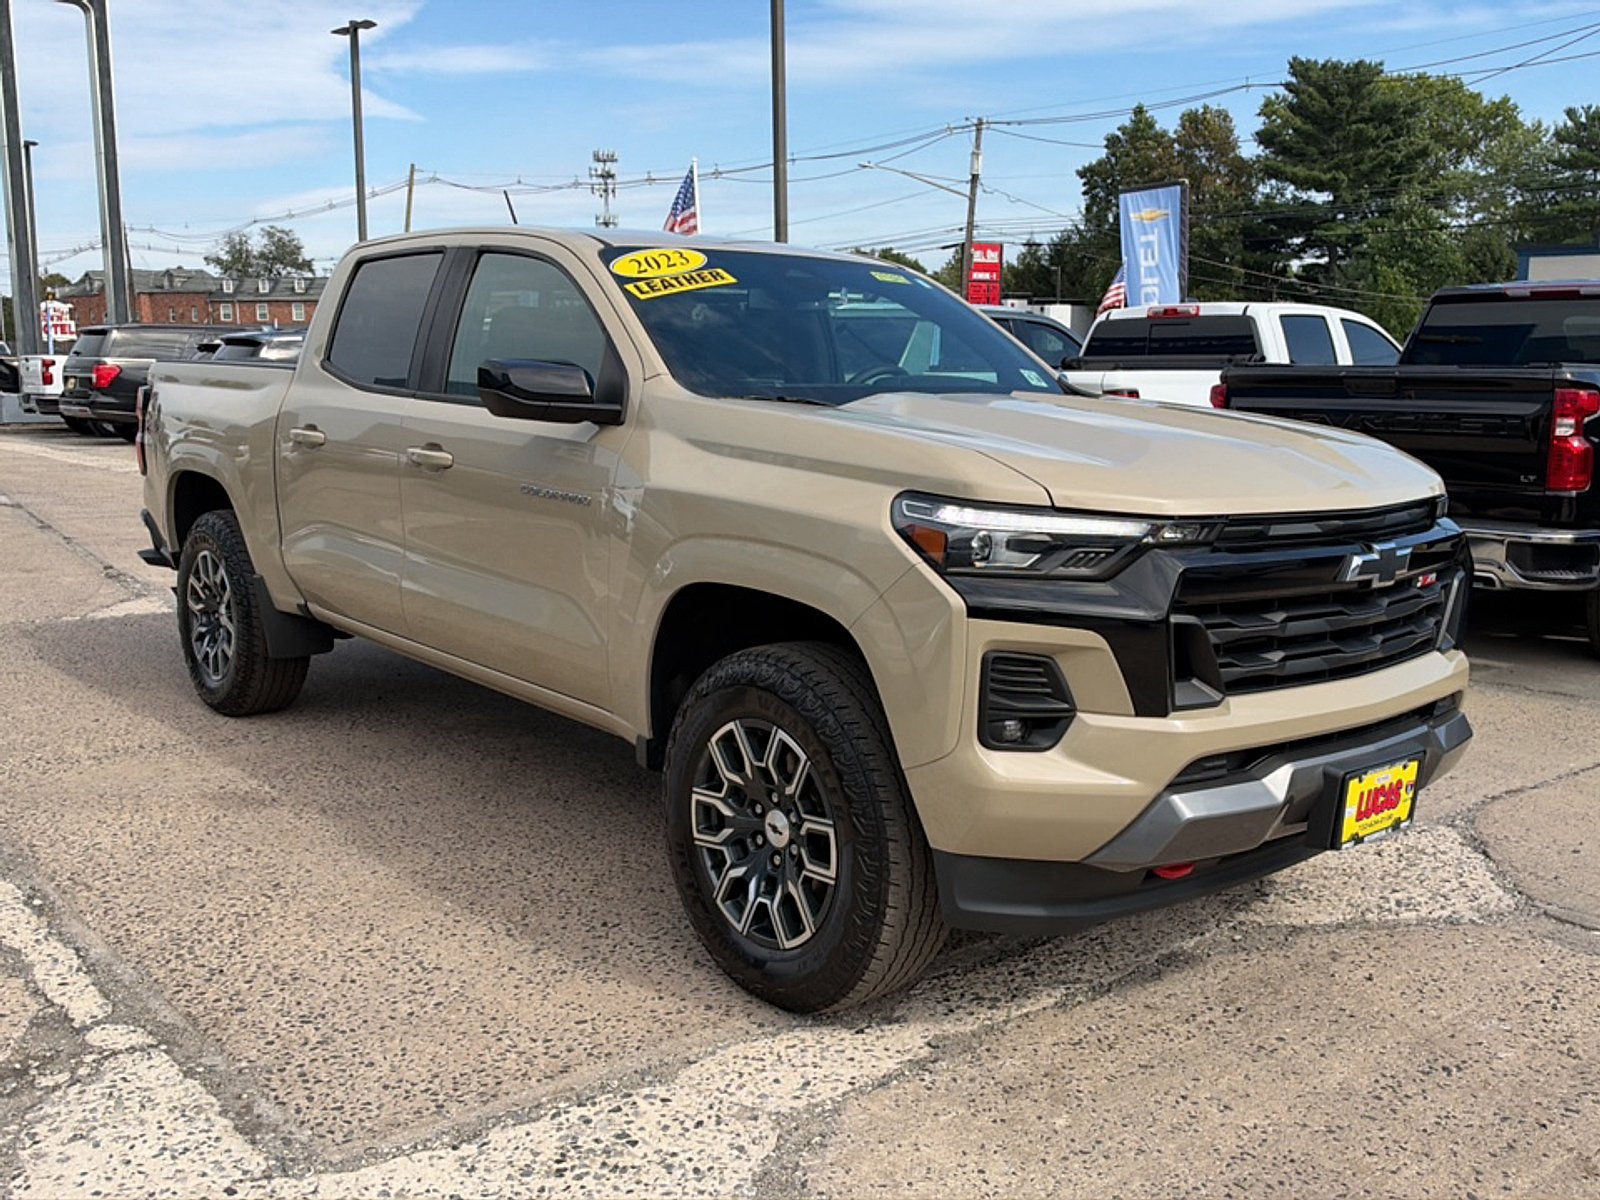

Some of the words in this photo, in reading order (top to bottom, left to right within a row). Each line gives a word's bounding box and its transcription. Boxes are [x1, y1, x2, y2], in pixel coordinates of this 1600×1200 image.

[628, 251, 690, 274] 2023
[633, 270, 725, 295] LEATHER
[1520, 474, 1537, 483] LT
[1355, 779, 1404, 822] LUCAS
